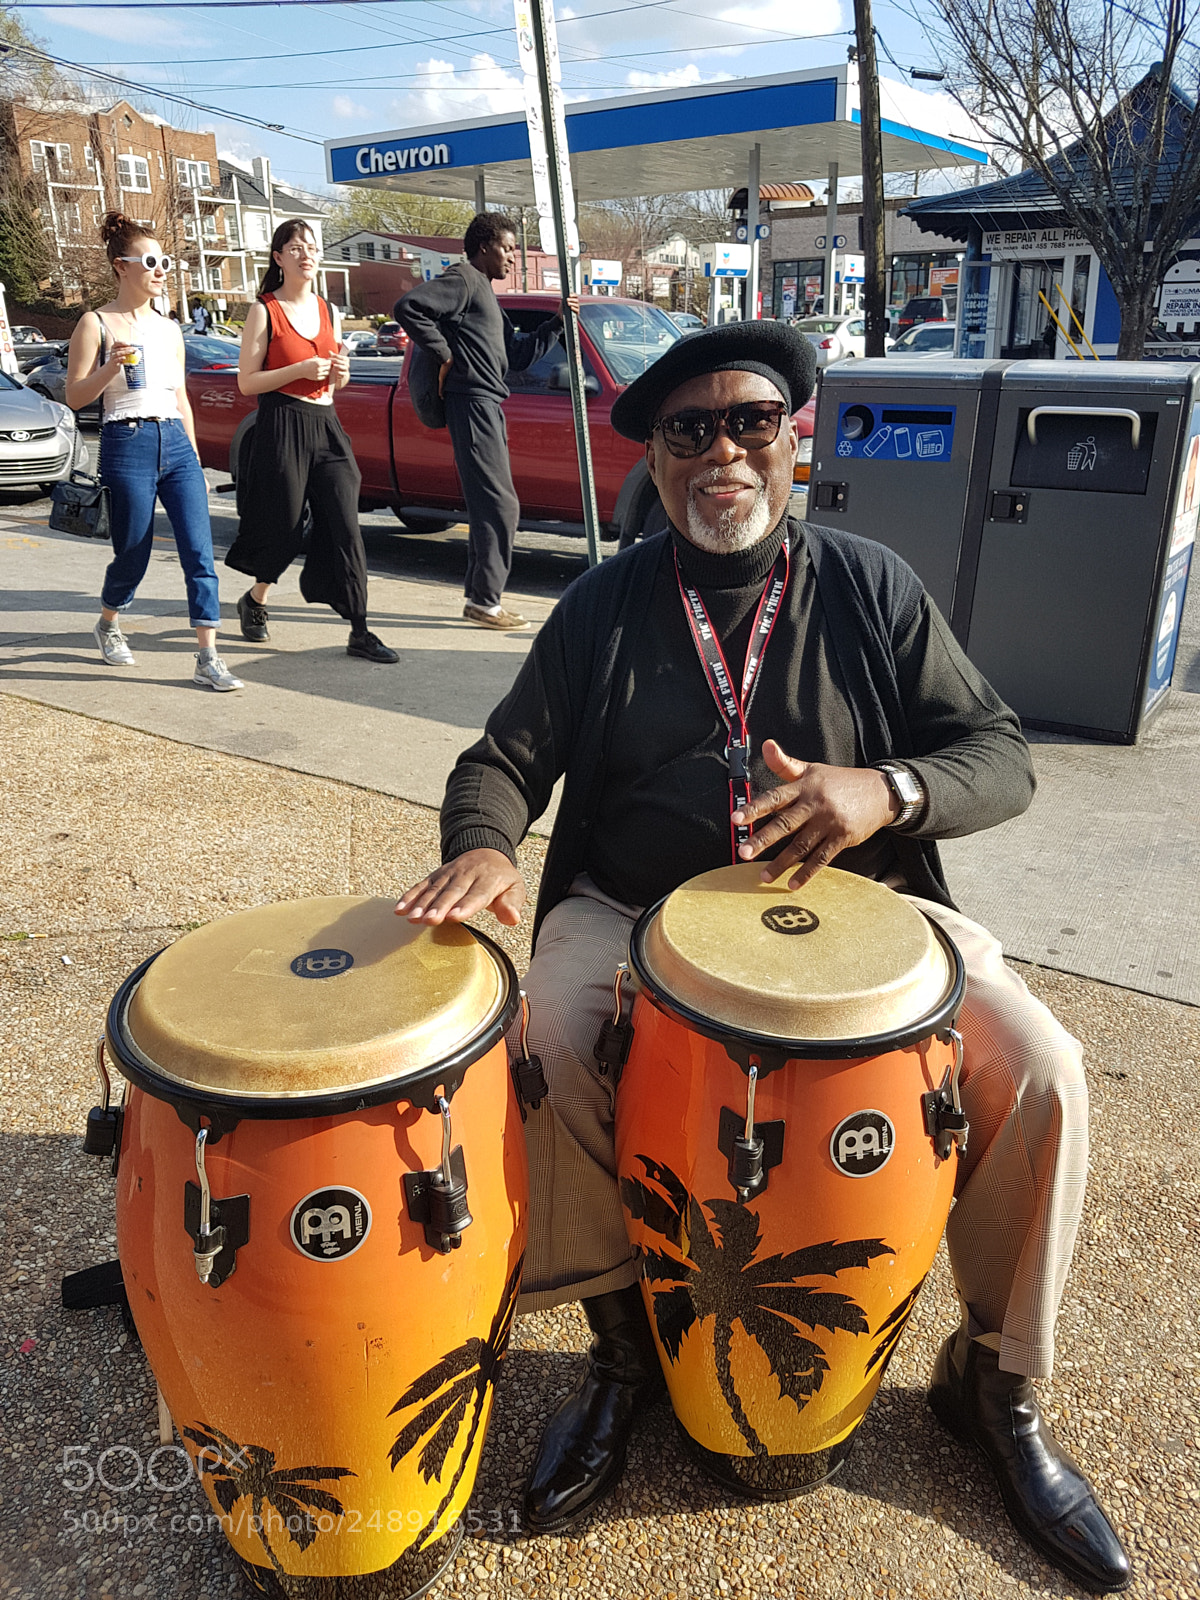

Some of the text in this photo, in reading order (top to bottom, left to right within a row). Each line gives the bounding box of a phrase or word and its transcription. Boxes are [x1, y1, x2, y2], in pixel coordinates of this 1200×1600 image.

[355, 143, 449, 174] Chevron
[986, 234, 1001, 245] WE
[1004, 231, 1037, 244] REPAIR
[1041, 231, 1059, 242] ALL
[687, 588, 713, 641] VIC FIRTH
[759, 580, 784, 634] VIC FIRTH
[712, 661, 737, 717] VIC FIRTH
[354, 1200, 363, 1237] MEINL
